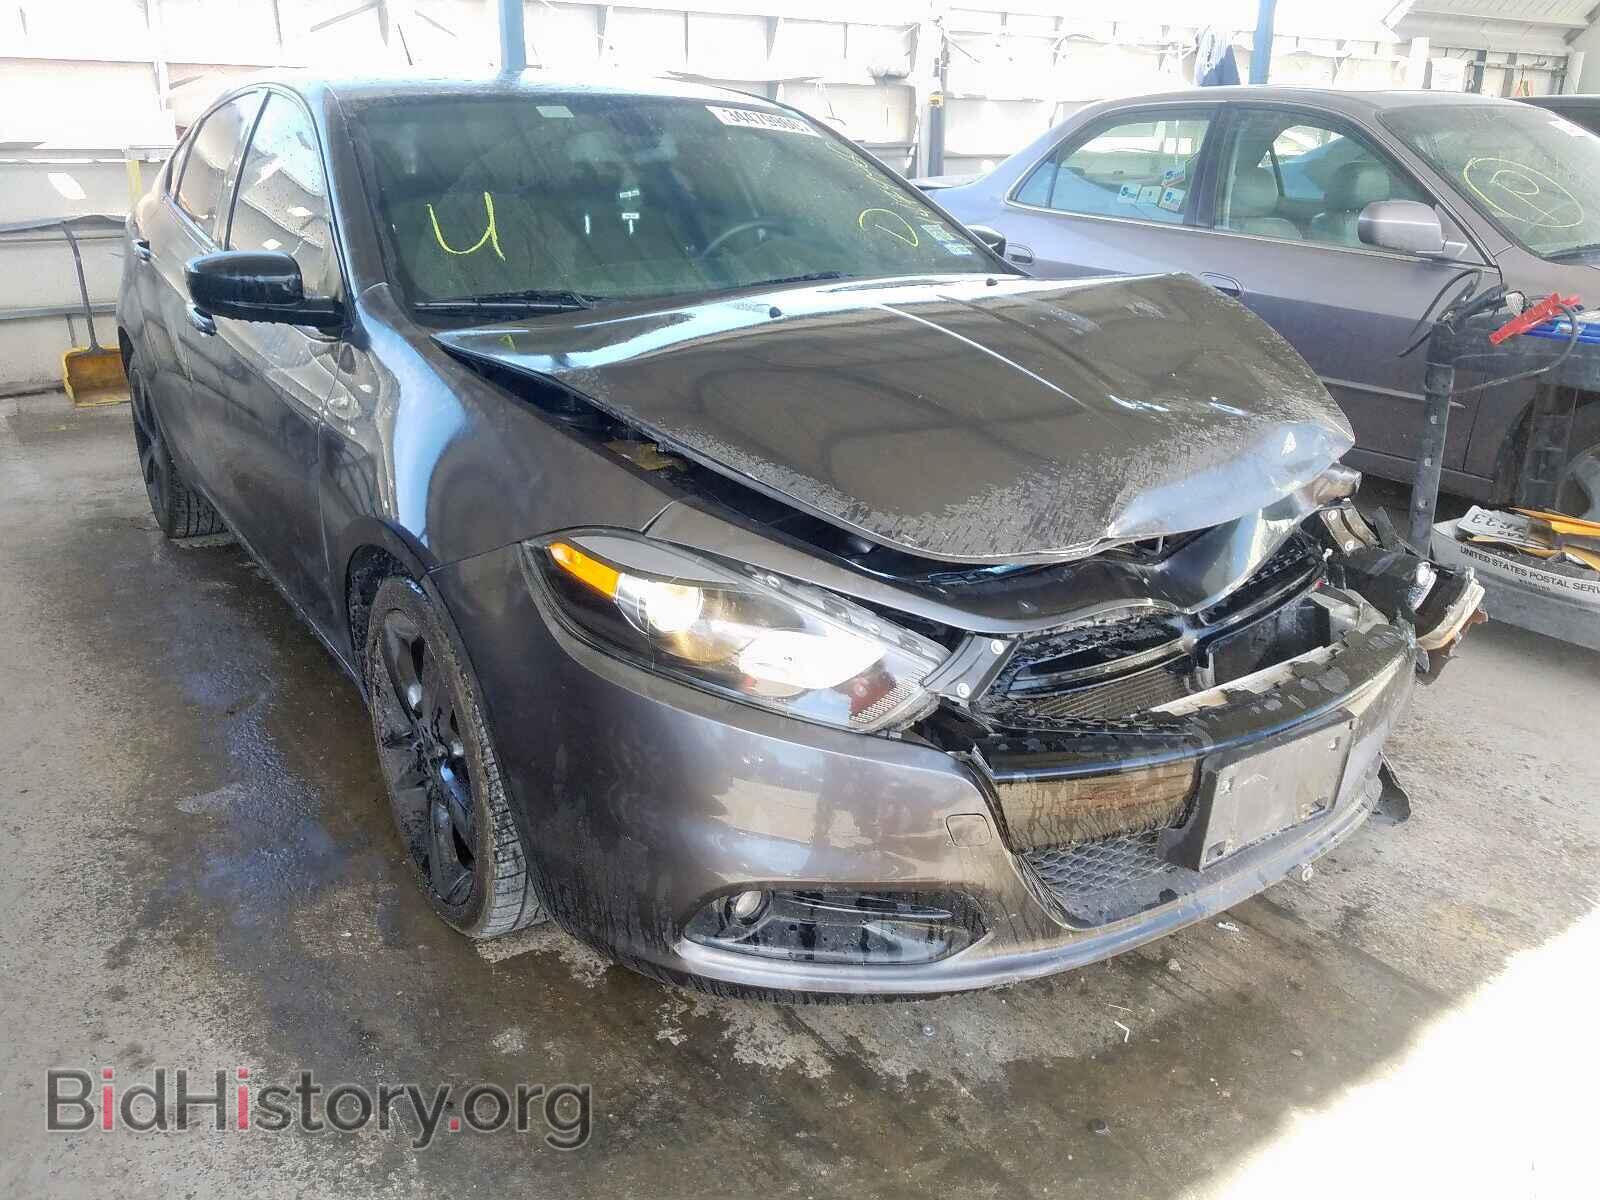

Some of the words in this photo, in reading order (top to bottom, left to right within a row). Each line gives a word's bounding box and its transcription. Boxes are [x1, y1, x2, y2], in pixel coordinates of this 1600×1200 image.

[1460, 545, 1491, 563] UNITED
[1491, 558, 1528, 577] STATES
[1529, 571, 1570, 588] POSTAL
